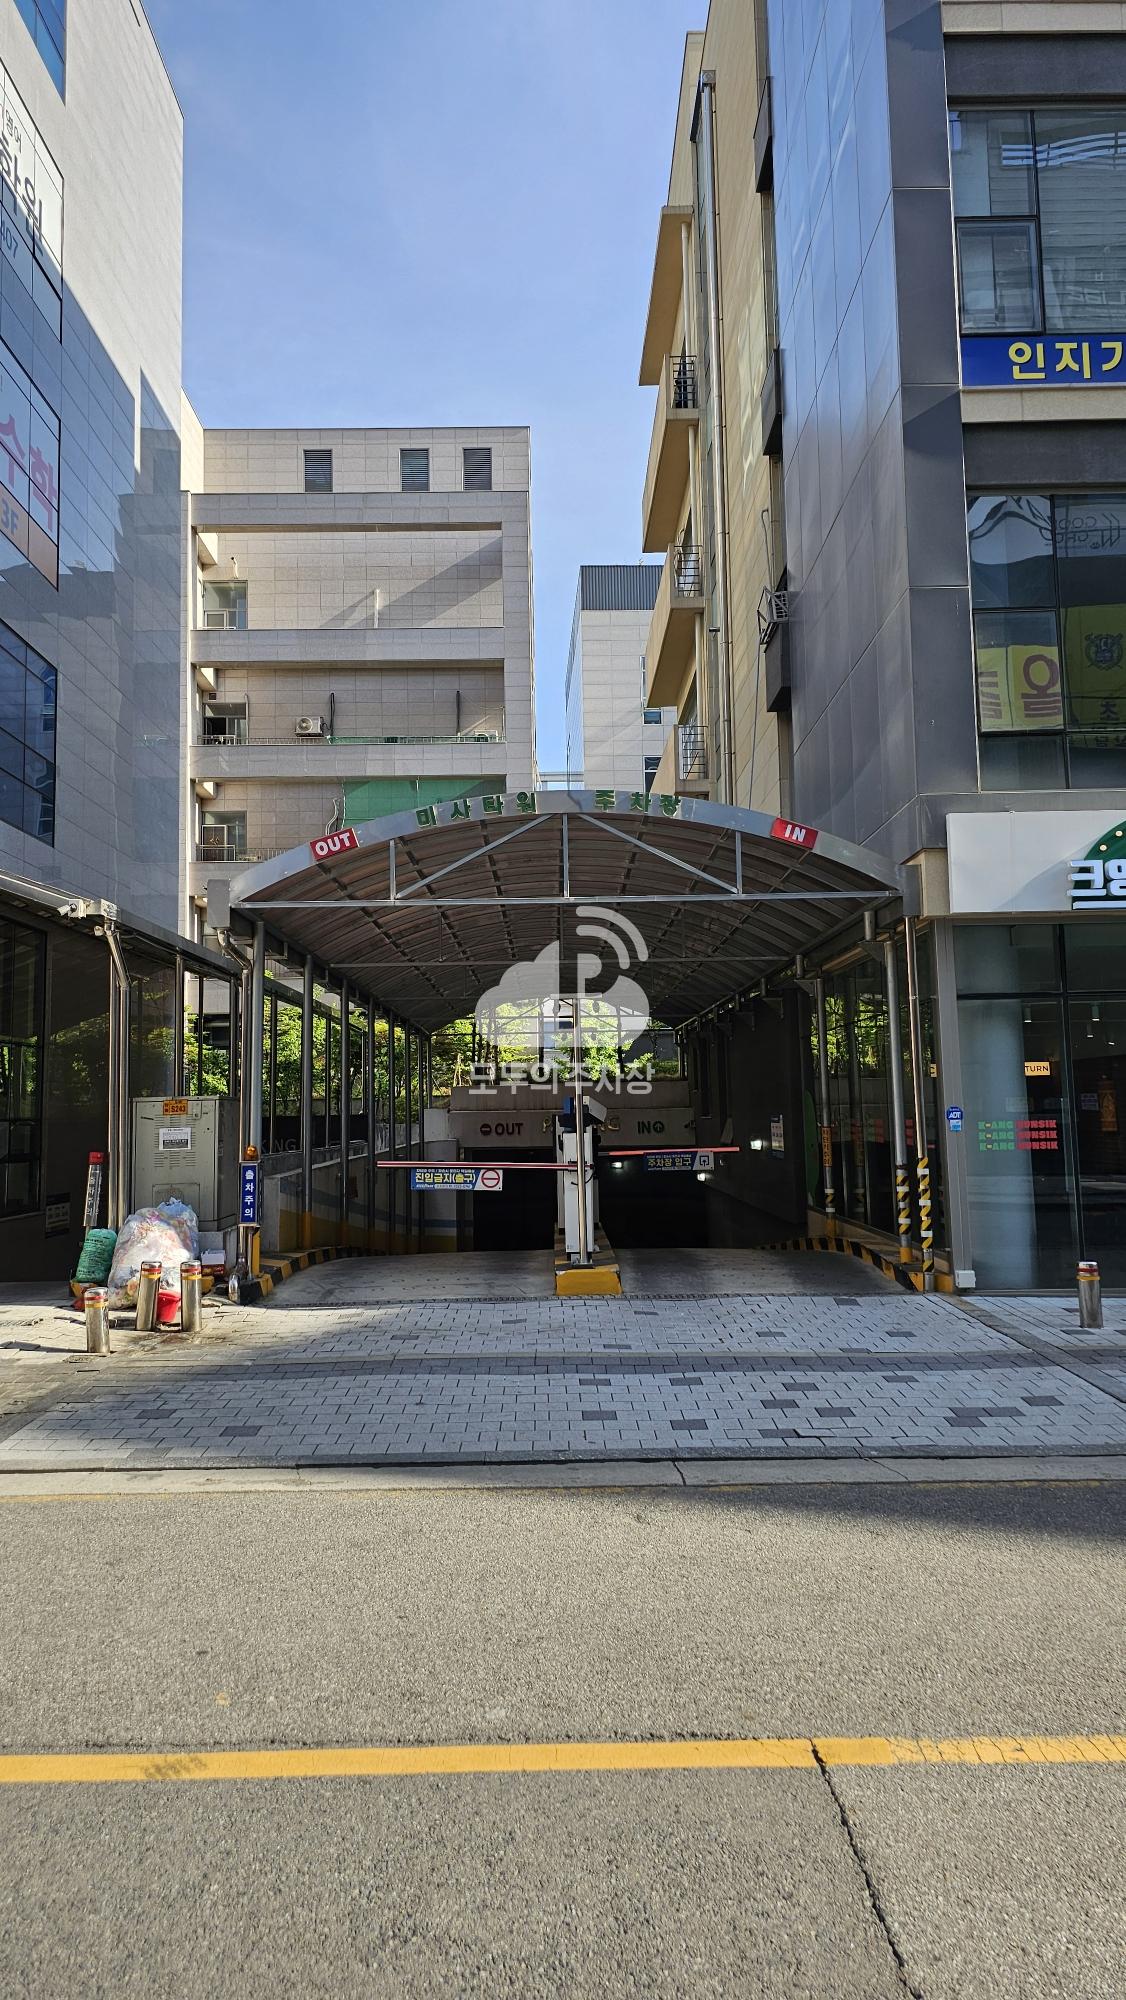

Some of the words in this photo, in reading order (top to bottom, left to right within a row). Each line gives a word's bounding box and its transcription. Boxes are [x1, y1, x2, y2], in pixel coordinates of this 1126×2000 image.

[595, 789, 682, 817] 주차장
[784, 824, 806, 842] IN
[315, 832, 350, 856] OUT
[948, 1111, 961, 1119] ADT
[494, 1122, 524, 1136] OUT
[637, 1121, 651, 1134] IN
[648, 1158, 672, 1167] 주차장
[415, 1172, 476, 1184] 진입금지(출구)
[244, 1169, 254, 1218] 출차주의
